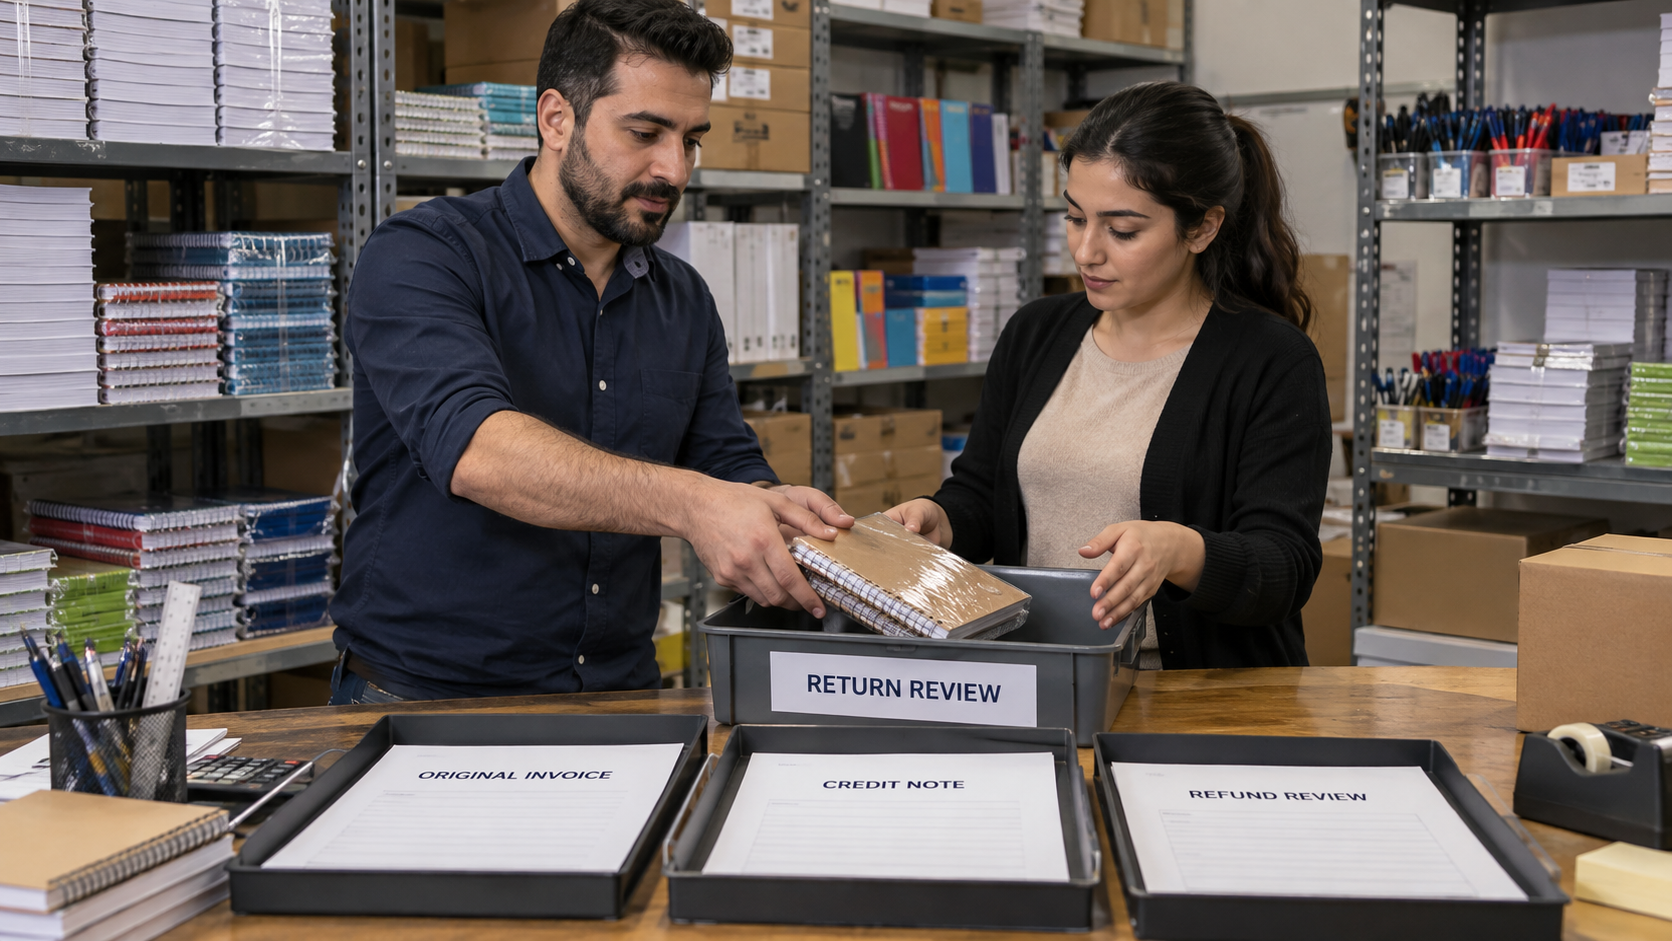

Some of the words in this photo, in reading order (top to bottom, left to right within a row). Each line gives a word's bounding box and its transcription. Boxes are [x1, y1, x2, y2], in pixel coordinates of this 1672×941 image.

[807, 673, 902, 698] RETURN
[909, 679, 1002, 704] REVIEW
[418, 772, 518, 780] ORIGINAL
[524, 771, 613, 780] INVOICE
[822, 781, 901, 790] CREDIT
[906, 781, 965, 789] NOTE
[1188, 791, 1278, 800] REFUND
[1283, 792, 1367, 802] REVIEW
